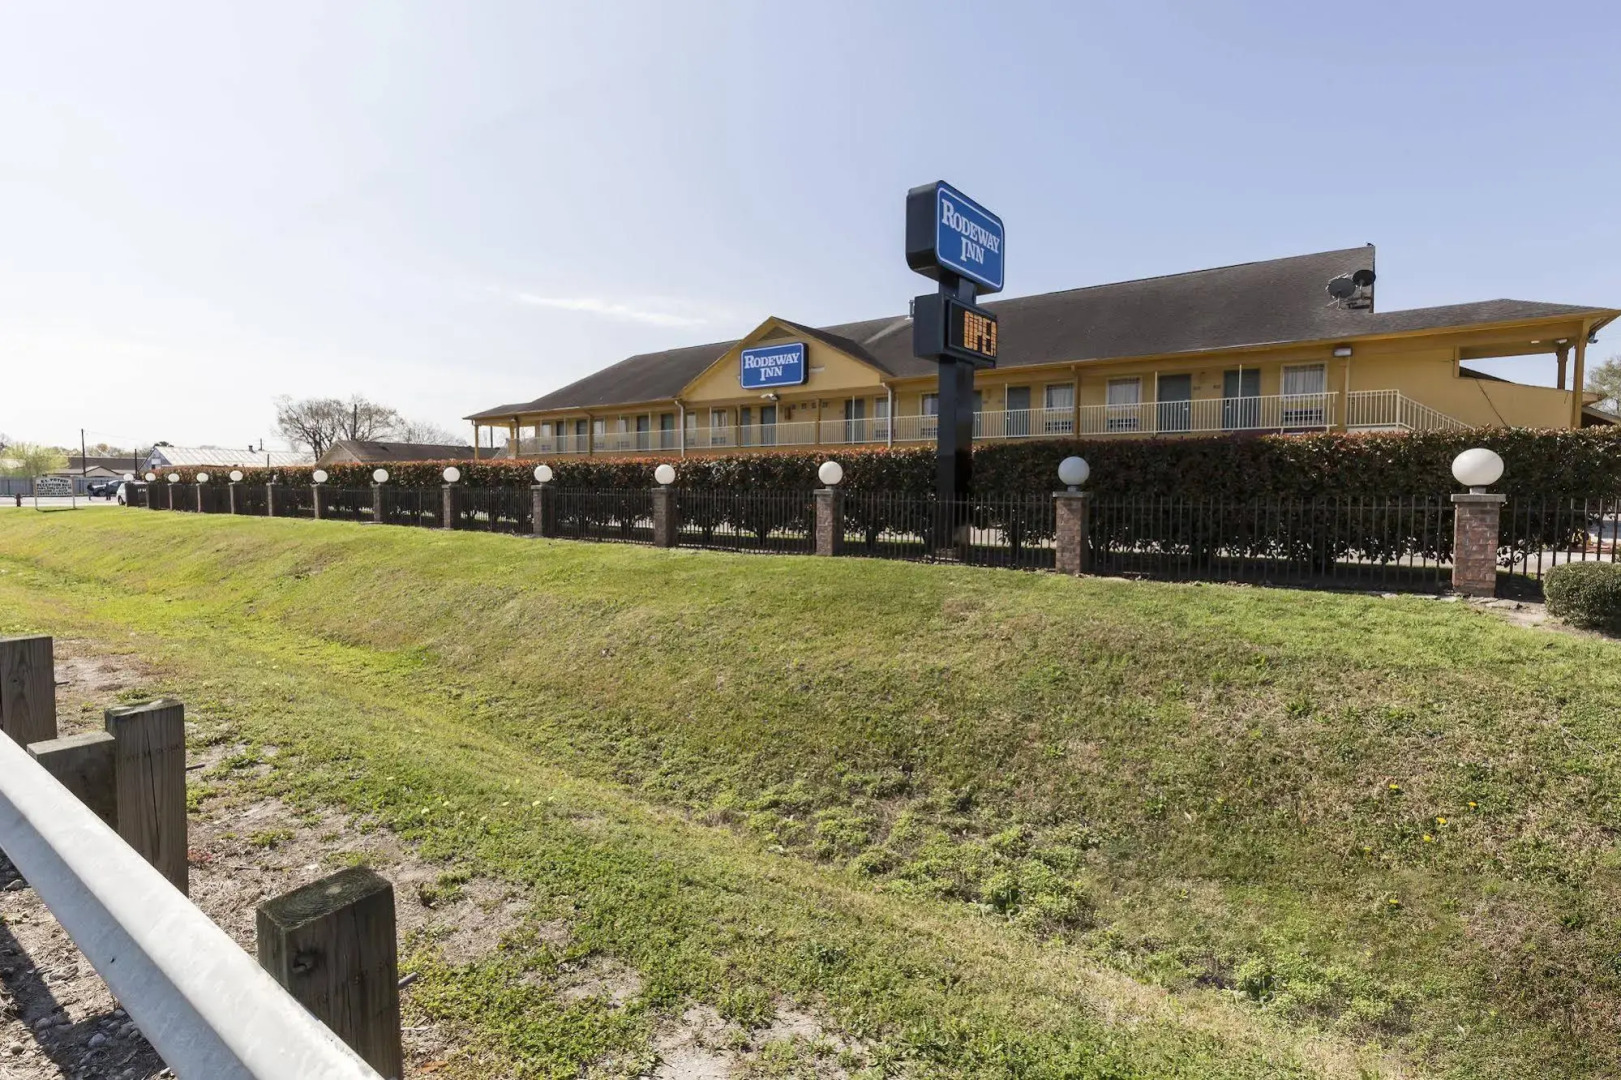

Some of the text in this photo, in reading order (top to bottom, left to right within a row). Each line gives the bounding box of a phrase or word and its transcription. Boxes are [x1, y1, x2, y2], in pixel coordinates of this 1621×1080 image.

[941, 198, 1000, 254] RODEWAY
[960, 236, 984, 265] INN
[744, 352, 800, 369] RODEWAY
[759, 366, 783, 381] INN
